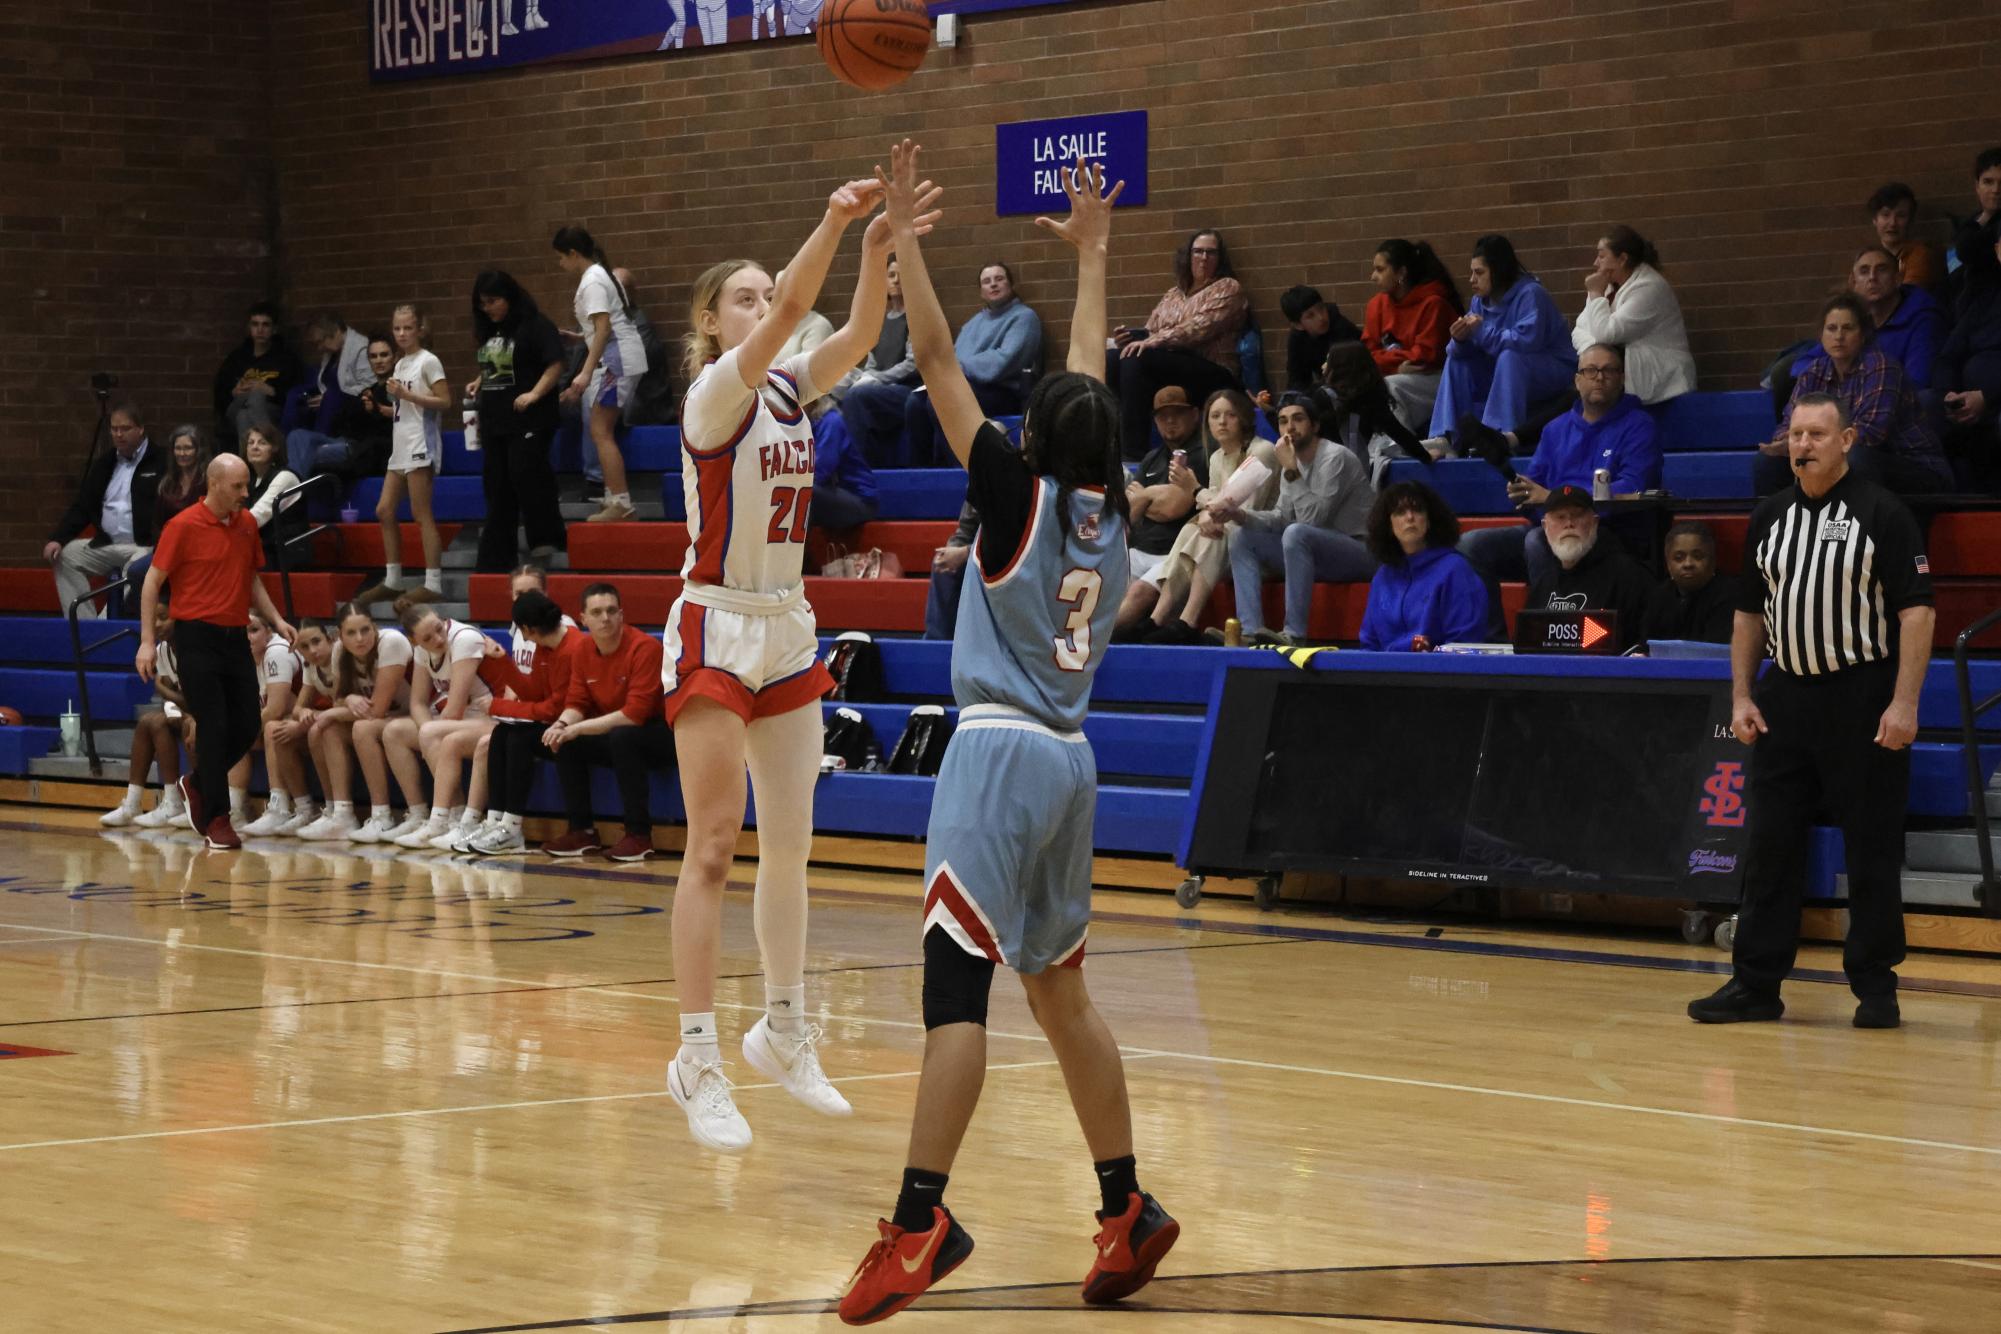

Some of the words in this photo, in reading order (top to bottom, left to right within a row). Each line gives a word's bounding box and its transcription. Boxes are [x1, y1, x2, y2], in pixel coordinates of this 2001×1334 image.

[1034, 137, 1055, 162] LA
[1059, 132, 1107, 160] SALLE
[1054, 567, 1103, 672] 3
[1548, 624, 1581, 640] POSS.
[1714, 724, 1726, 738] LA
[1408, 870, 1438, 878] SIDELINE
